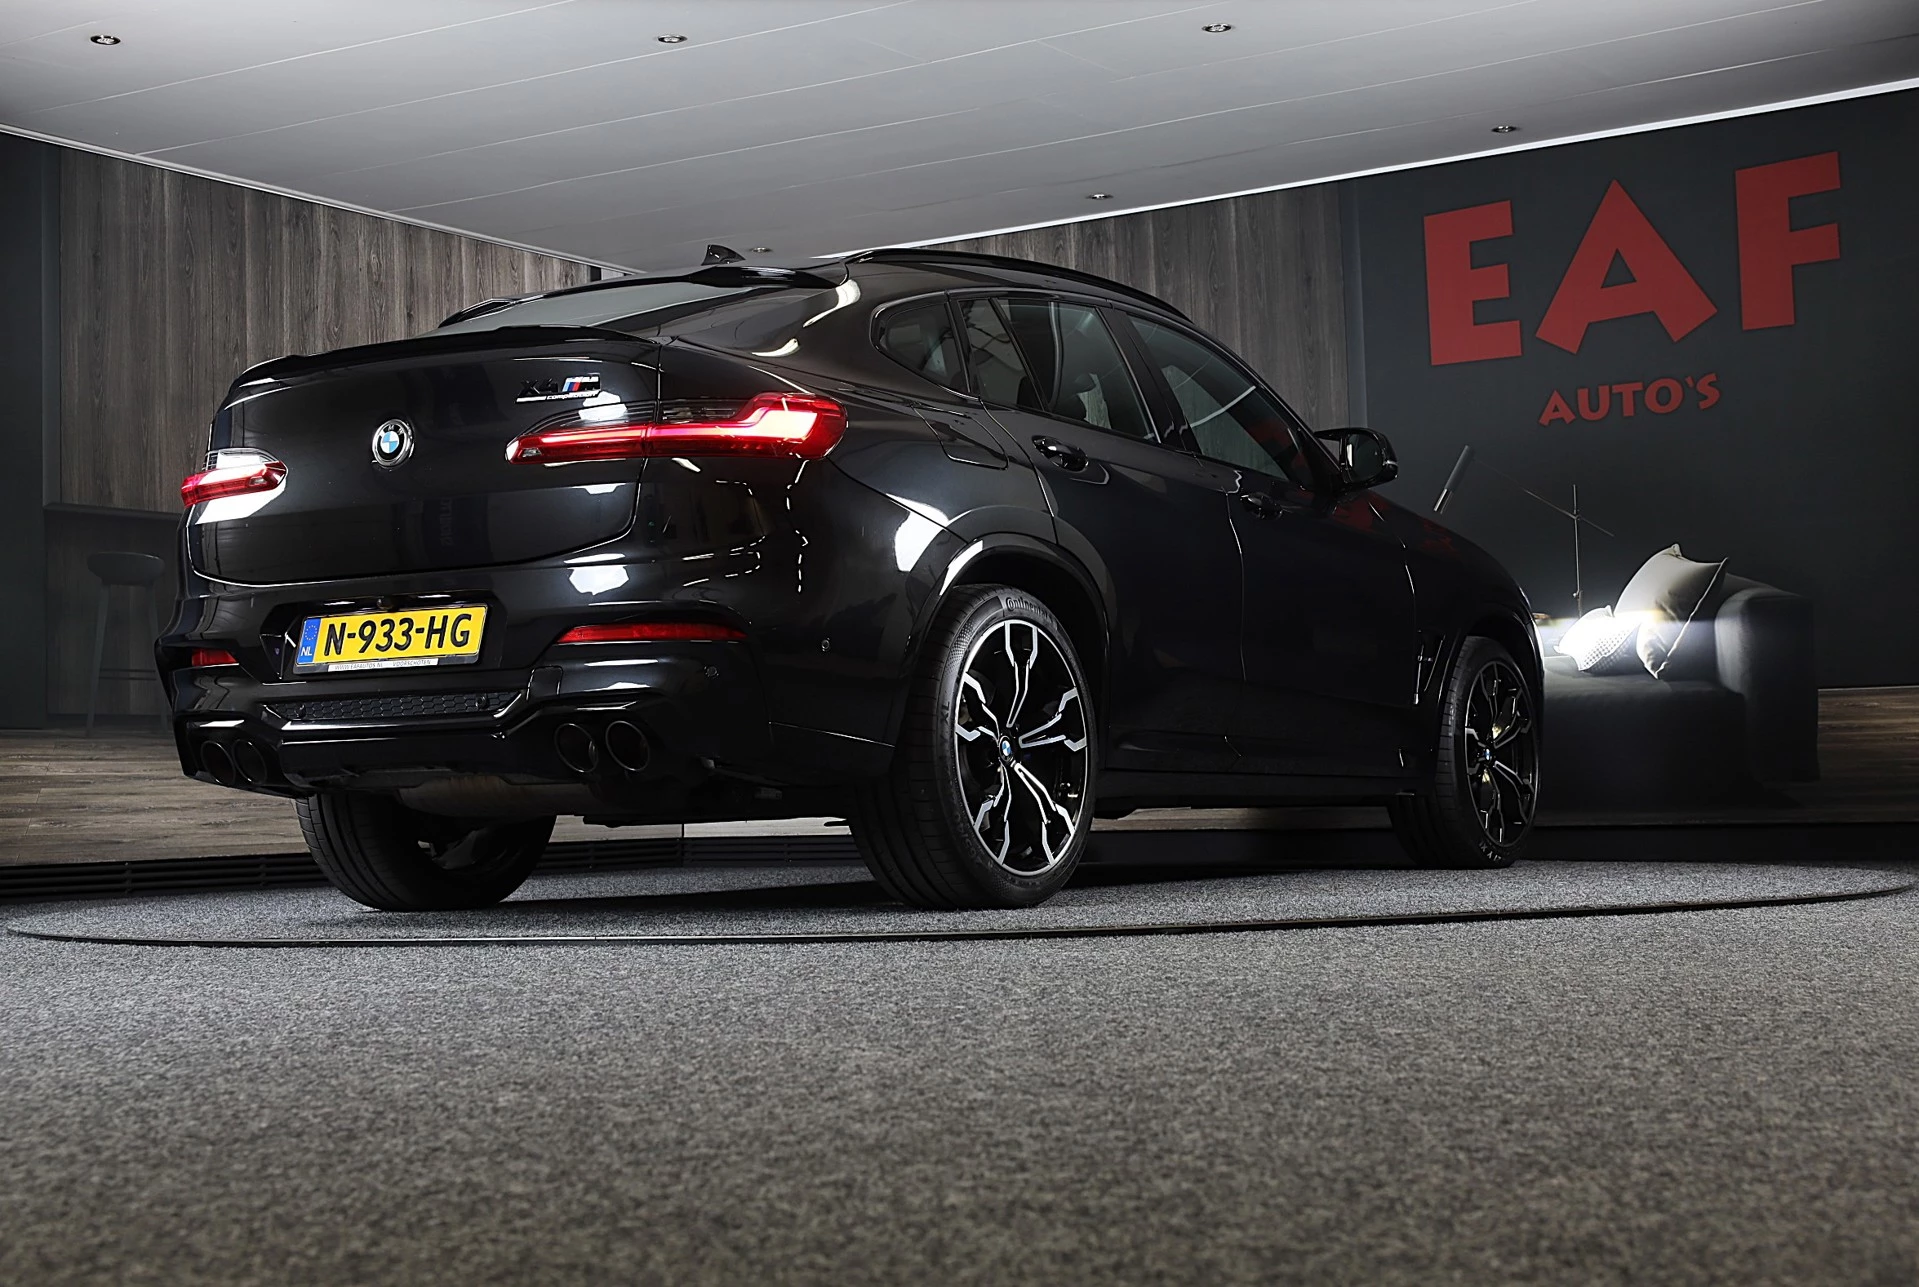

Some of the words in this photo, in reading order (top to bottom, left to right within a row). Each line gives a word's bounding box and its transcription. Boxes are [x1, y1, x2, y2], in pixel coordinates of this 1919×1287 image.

[1423, 151, 1841, 366] EAF
[1538, 372, 1721, 426] AUTO'S
[301, 646, 313, 656] NL
[323, 613, 472, 656] N-933-HG
